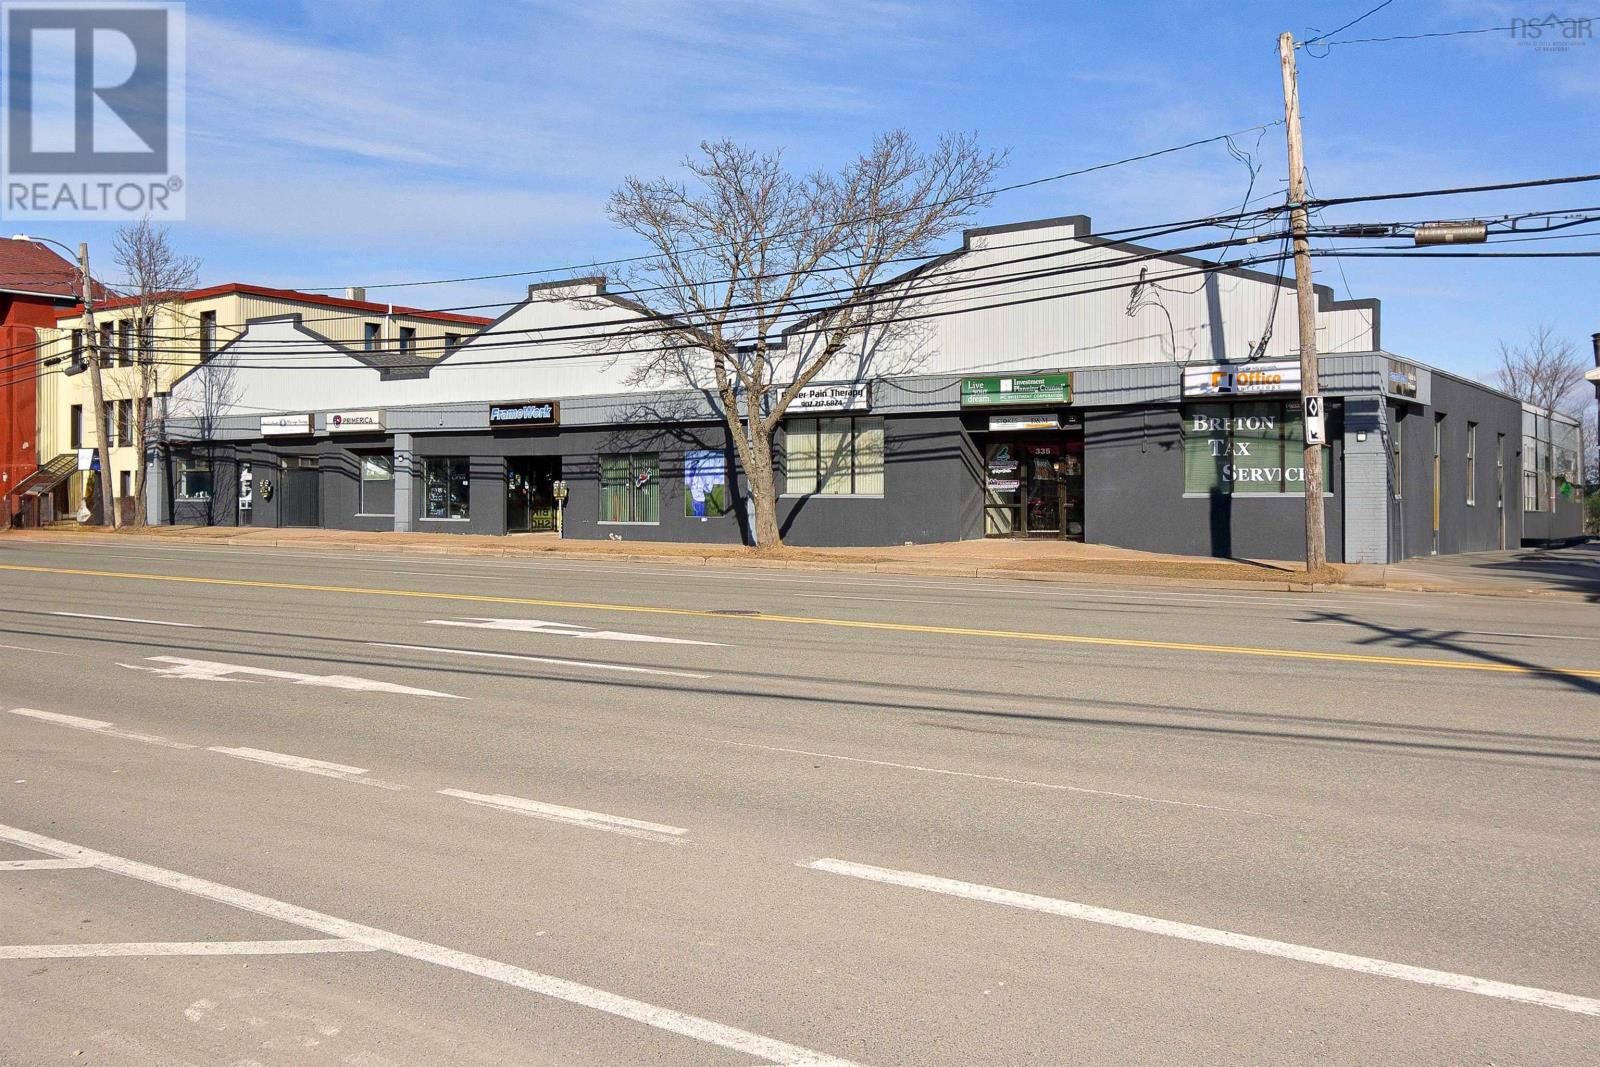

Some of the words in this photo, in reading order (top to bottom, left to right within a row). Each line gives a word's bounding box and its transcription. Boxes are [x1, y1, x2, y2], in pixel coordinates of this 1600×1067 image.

[1236, 371, 1282, 386] Office
[968, 381, 984, 389] Live
[809, 390, 827, 398] Pain
[830, 389, 863, 398] Therapy
[490, 404, 552, 420] FrameWork
[342, 416, 373, 424] PRIMERICA
[1035, 447, 1051, 455] 335
